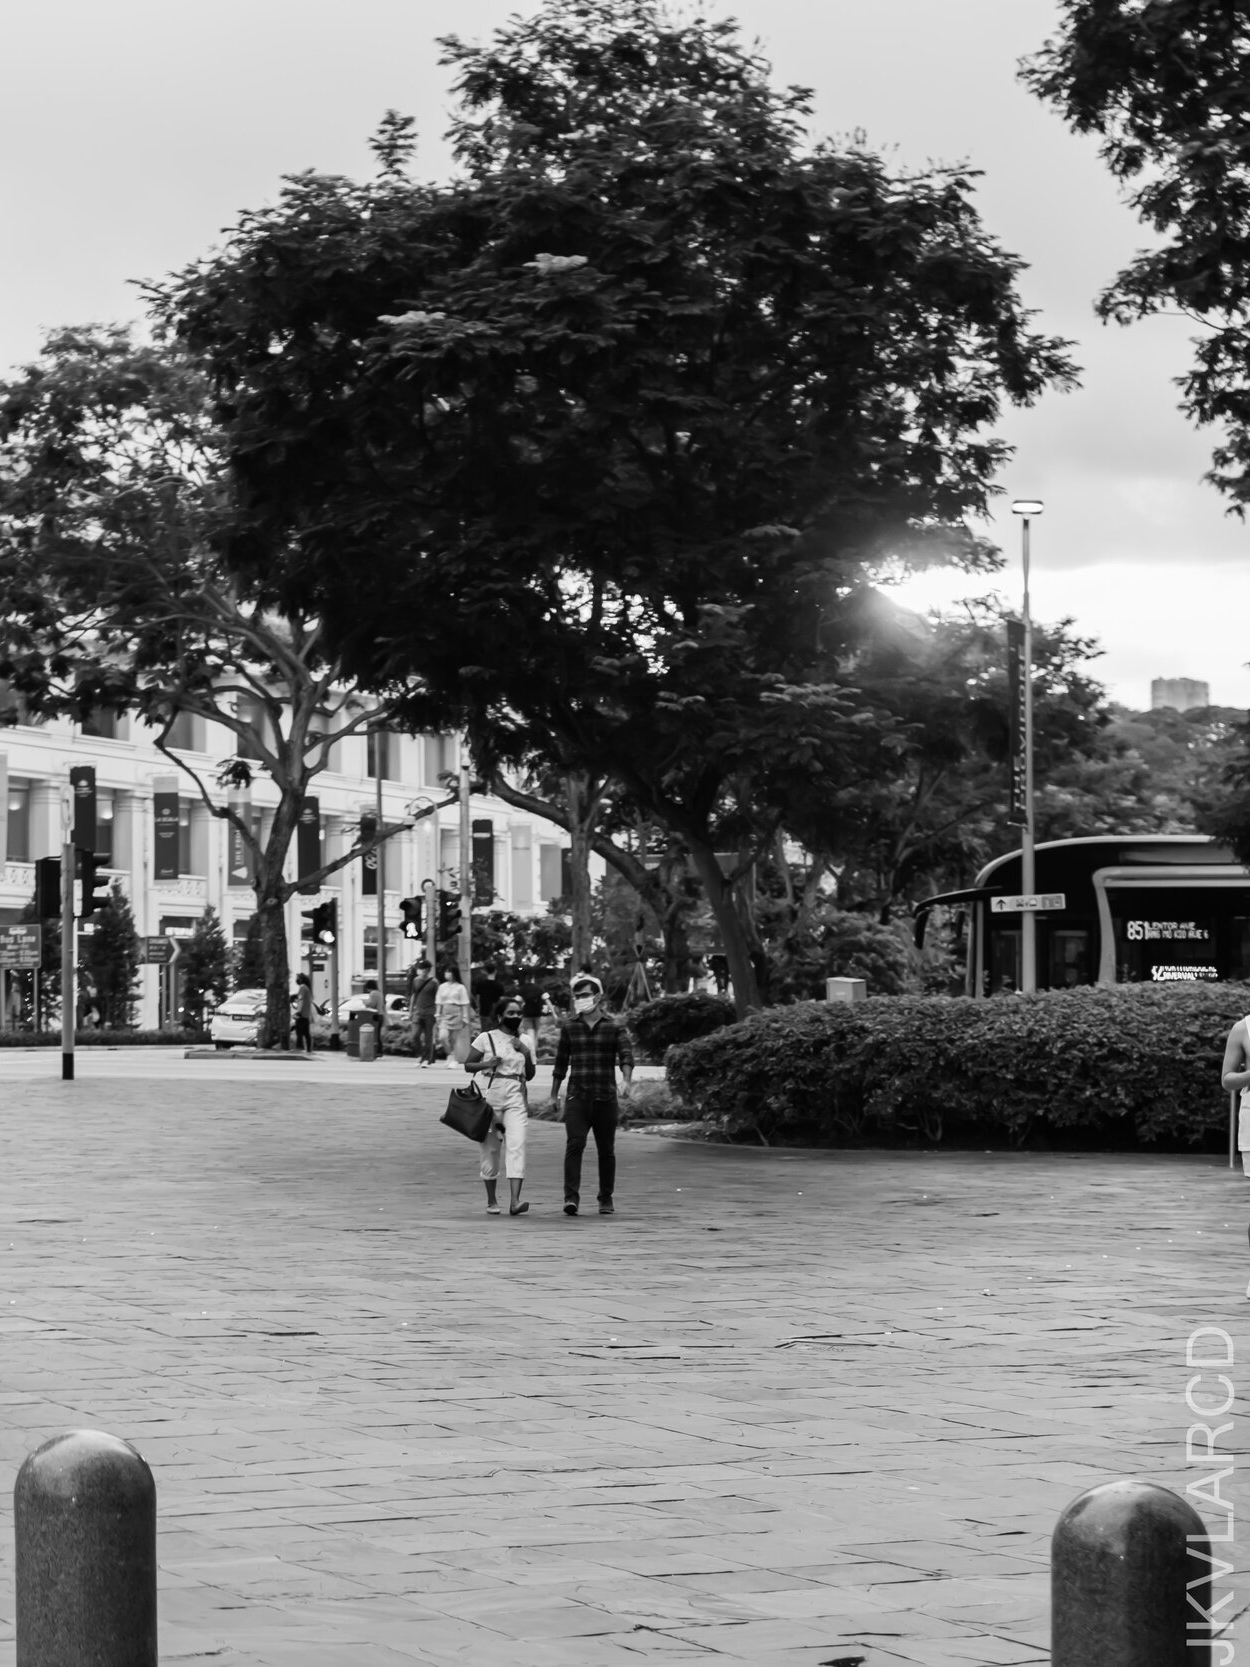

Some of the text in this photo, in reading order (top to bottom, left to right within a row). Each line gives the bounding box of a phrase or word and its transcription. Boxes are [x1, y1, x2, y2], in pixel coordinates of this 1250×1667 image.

[1127, 920, 1149, 940] 851
[1149, 921, 1178, 930] LENTOR
[0, 934, 36, 944] Bus Lane
